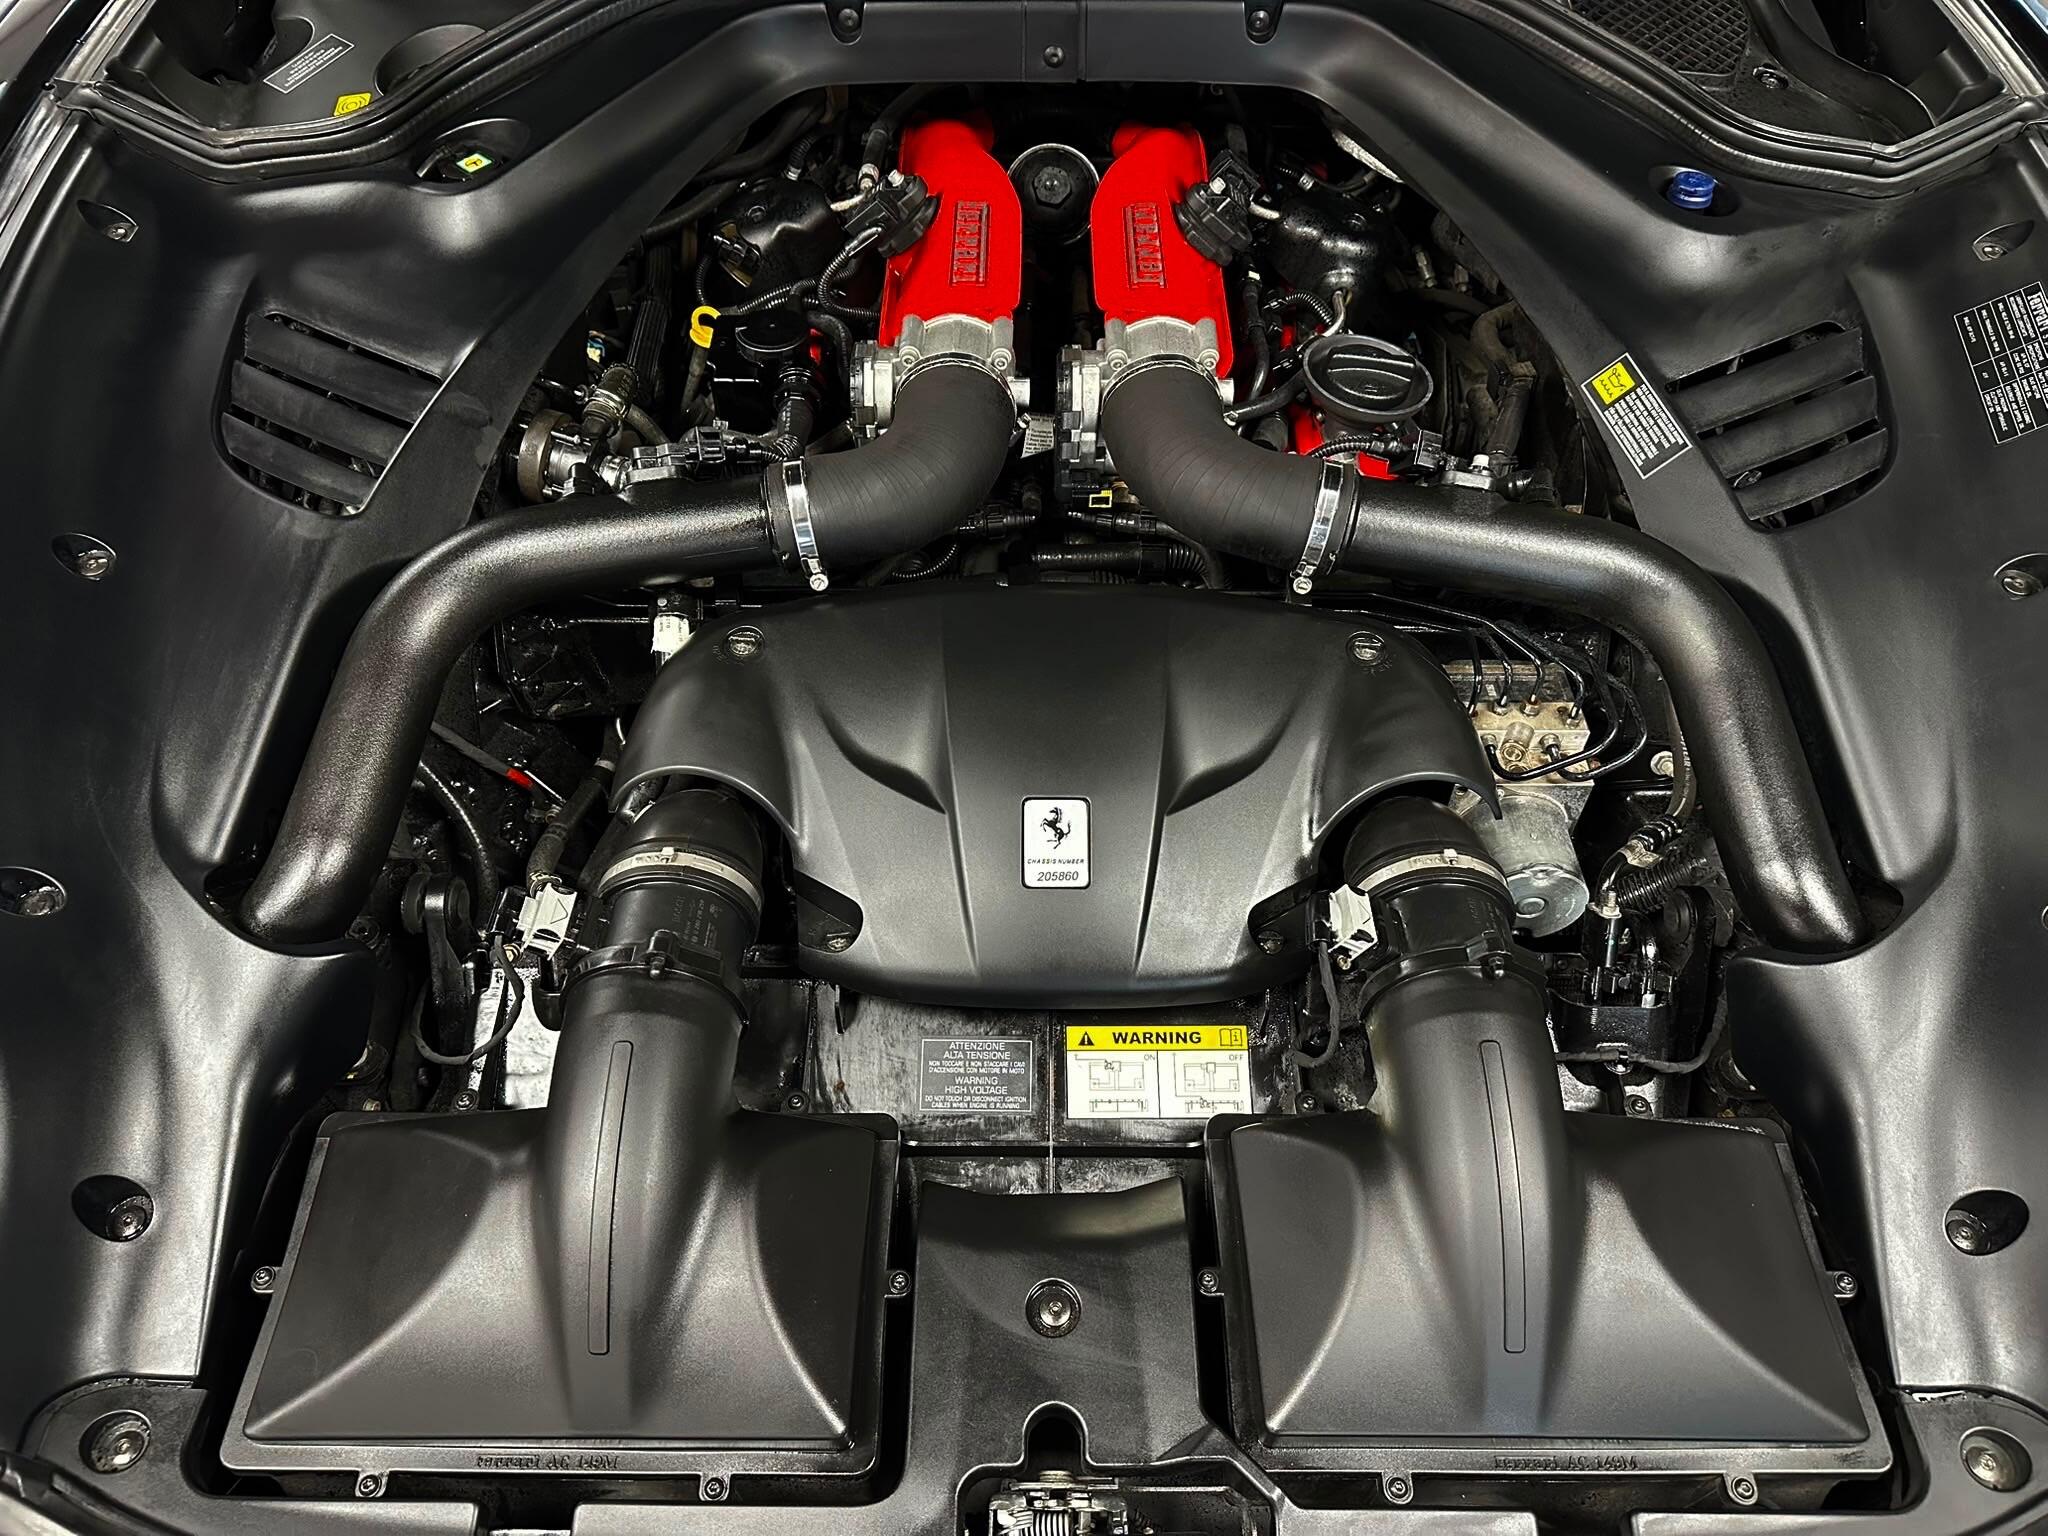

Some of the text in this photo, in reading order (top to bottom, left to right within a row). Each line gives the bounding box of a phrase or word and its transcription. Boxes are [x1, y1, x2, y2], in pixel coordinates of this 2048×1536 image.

[1037, 871, 1079, 882] 205860
[1112, 1032, 1202, 1044] WARNING
[950, 1042, 1006, 1050] ATTENZIONE
[943, 1051, 1010, 1060] ALTA TENSIONE
[954, 1076, 998, 1085] WARNING
[944, 1086, 1008, 1094] HIGH VOLTAGE
